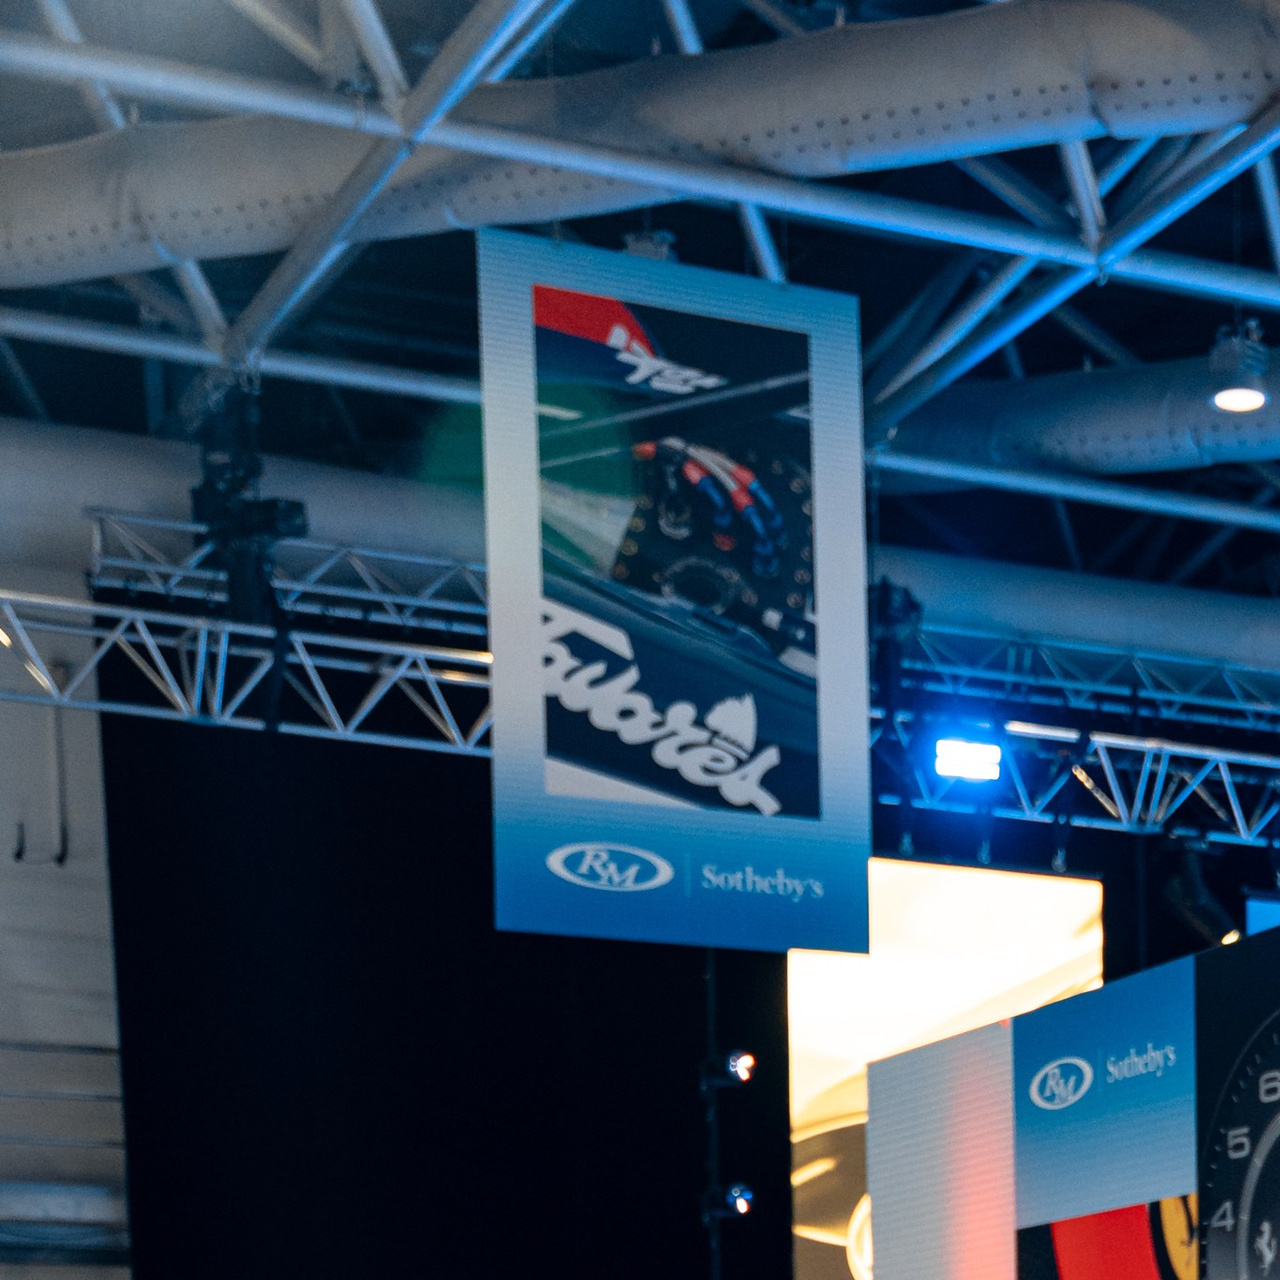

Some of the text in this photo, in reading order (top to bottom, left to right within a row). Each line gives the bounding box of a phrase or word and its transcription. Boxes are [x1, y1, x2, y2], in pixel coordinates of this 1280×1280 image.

[578, 848, 824, 902] RM Sotheby's
[1106, 1044, 1178, 1083] Sotheby's
[1226, 1125, 1250, 1159] 5
[1210, 1200, 1235, 1231] 4
